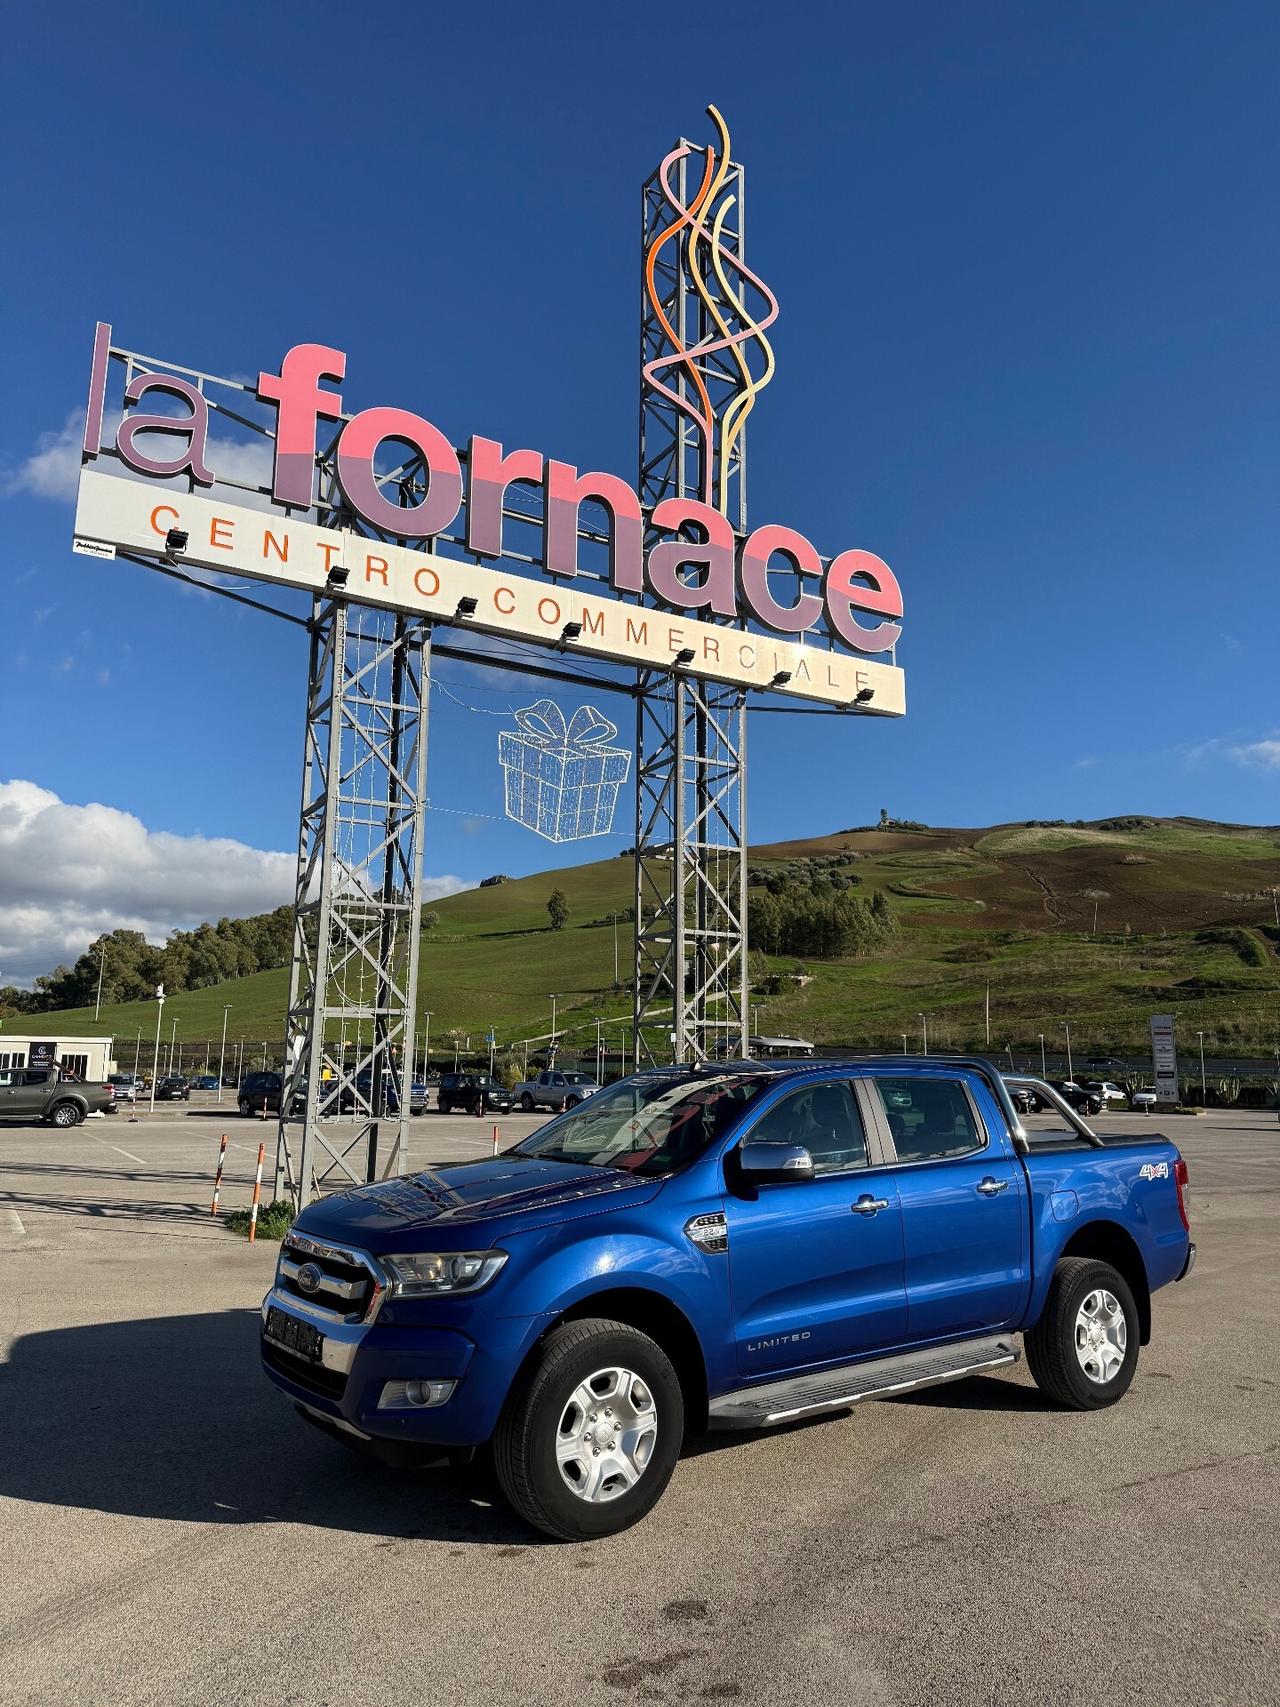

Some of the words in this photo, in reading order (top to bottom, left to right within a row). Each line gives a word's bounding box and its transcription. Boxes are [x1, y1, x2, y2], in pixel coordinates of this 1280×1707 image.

[84, 321, 215, 487] la
[255, 343, 904, 653] fornace
[150, 505, 440, 597] CENTRO
[493, 587, 869, 692] COMMERCIALE
[748, 1331, 811, 1351] LIMITED
